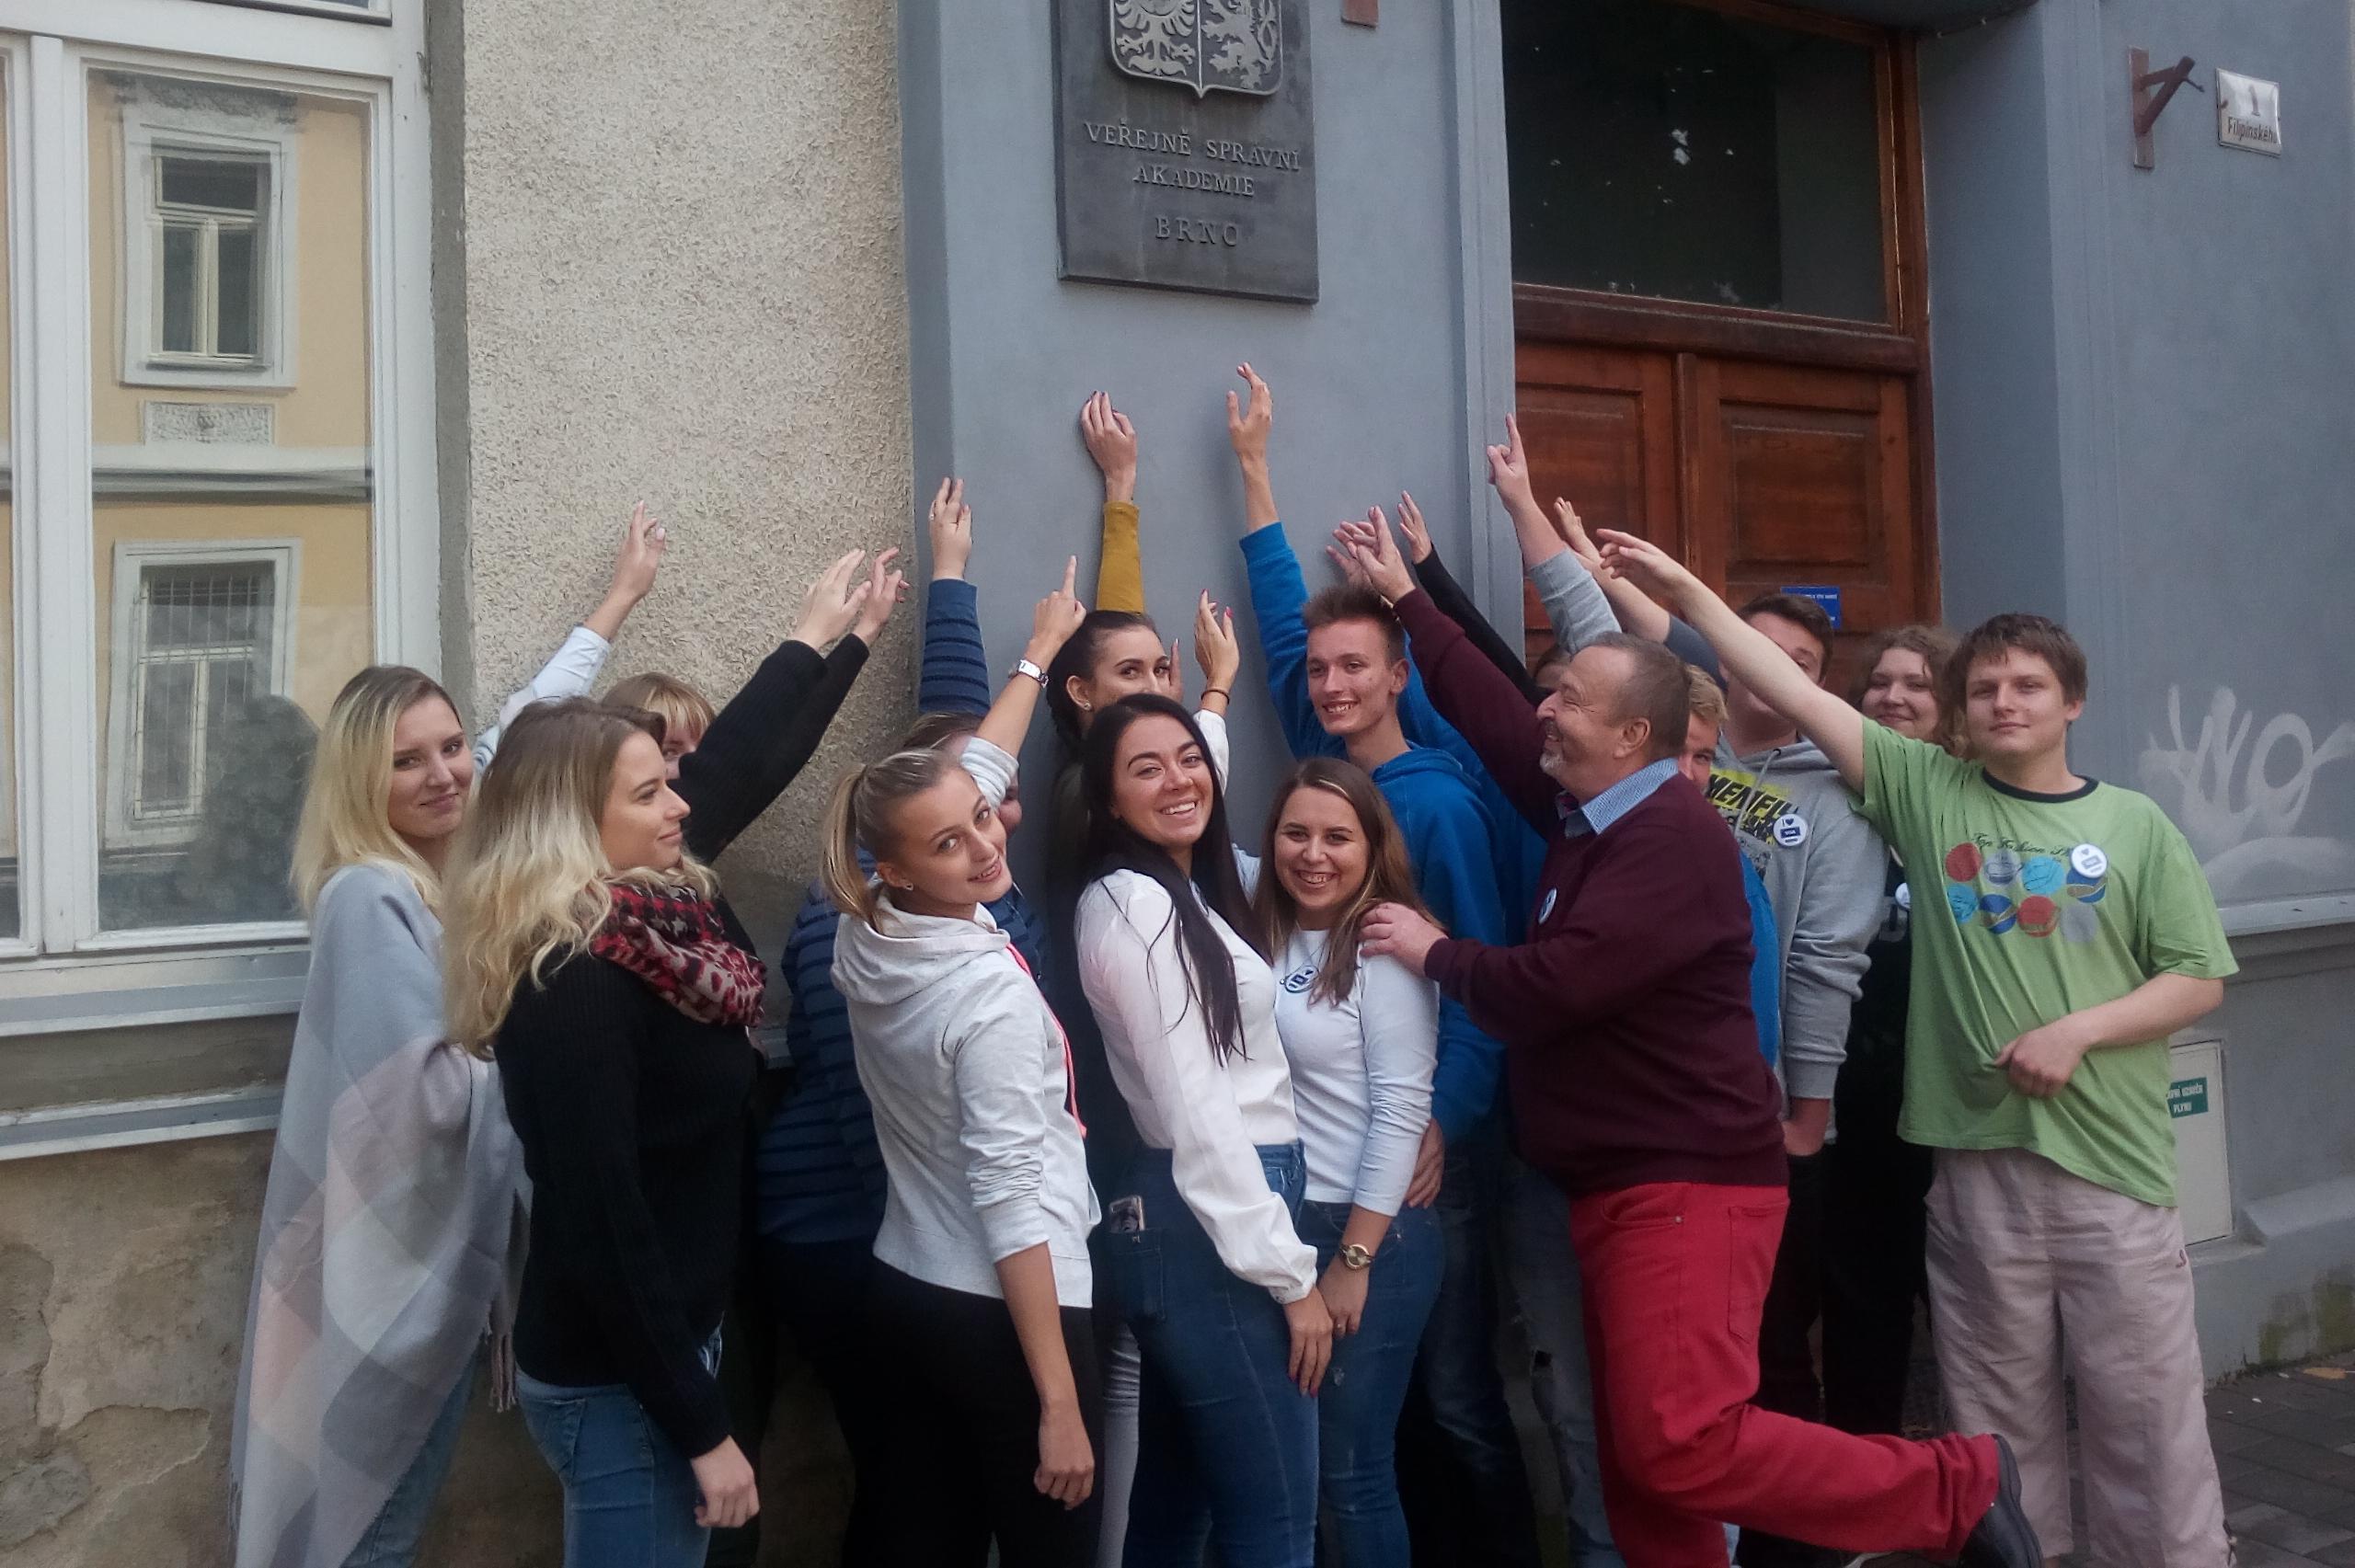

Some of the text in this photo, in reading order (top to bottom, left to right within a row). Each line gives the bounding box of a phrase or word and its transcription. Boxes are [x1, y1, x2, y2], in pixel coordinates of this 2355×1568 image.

[1084, 117, 1191, 156] VEŘEJNĚ
[1132, 163, 1255, 198] AKADEMIE
[1155, 215, 1239, 247] BRNO
